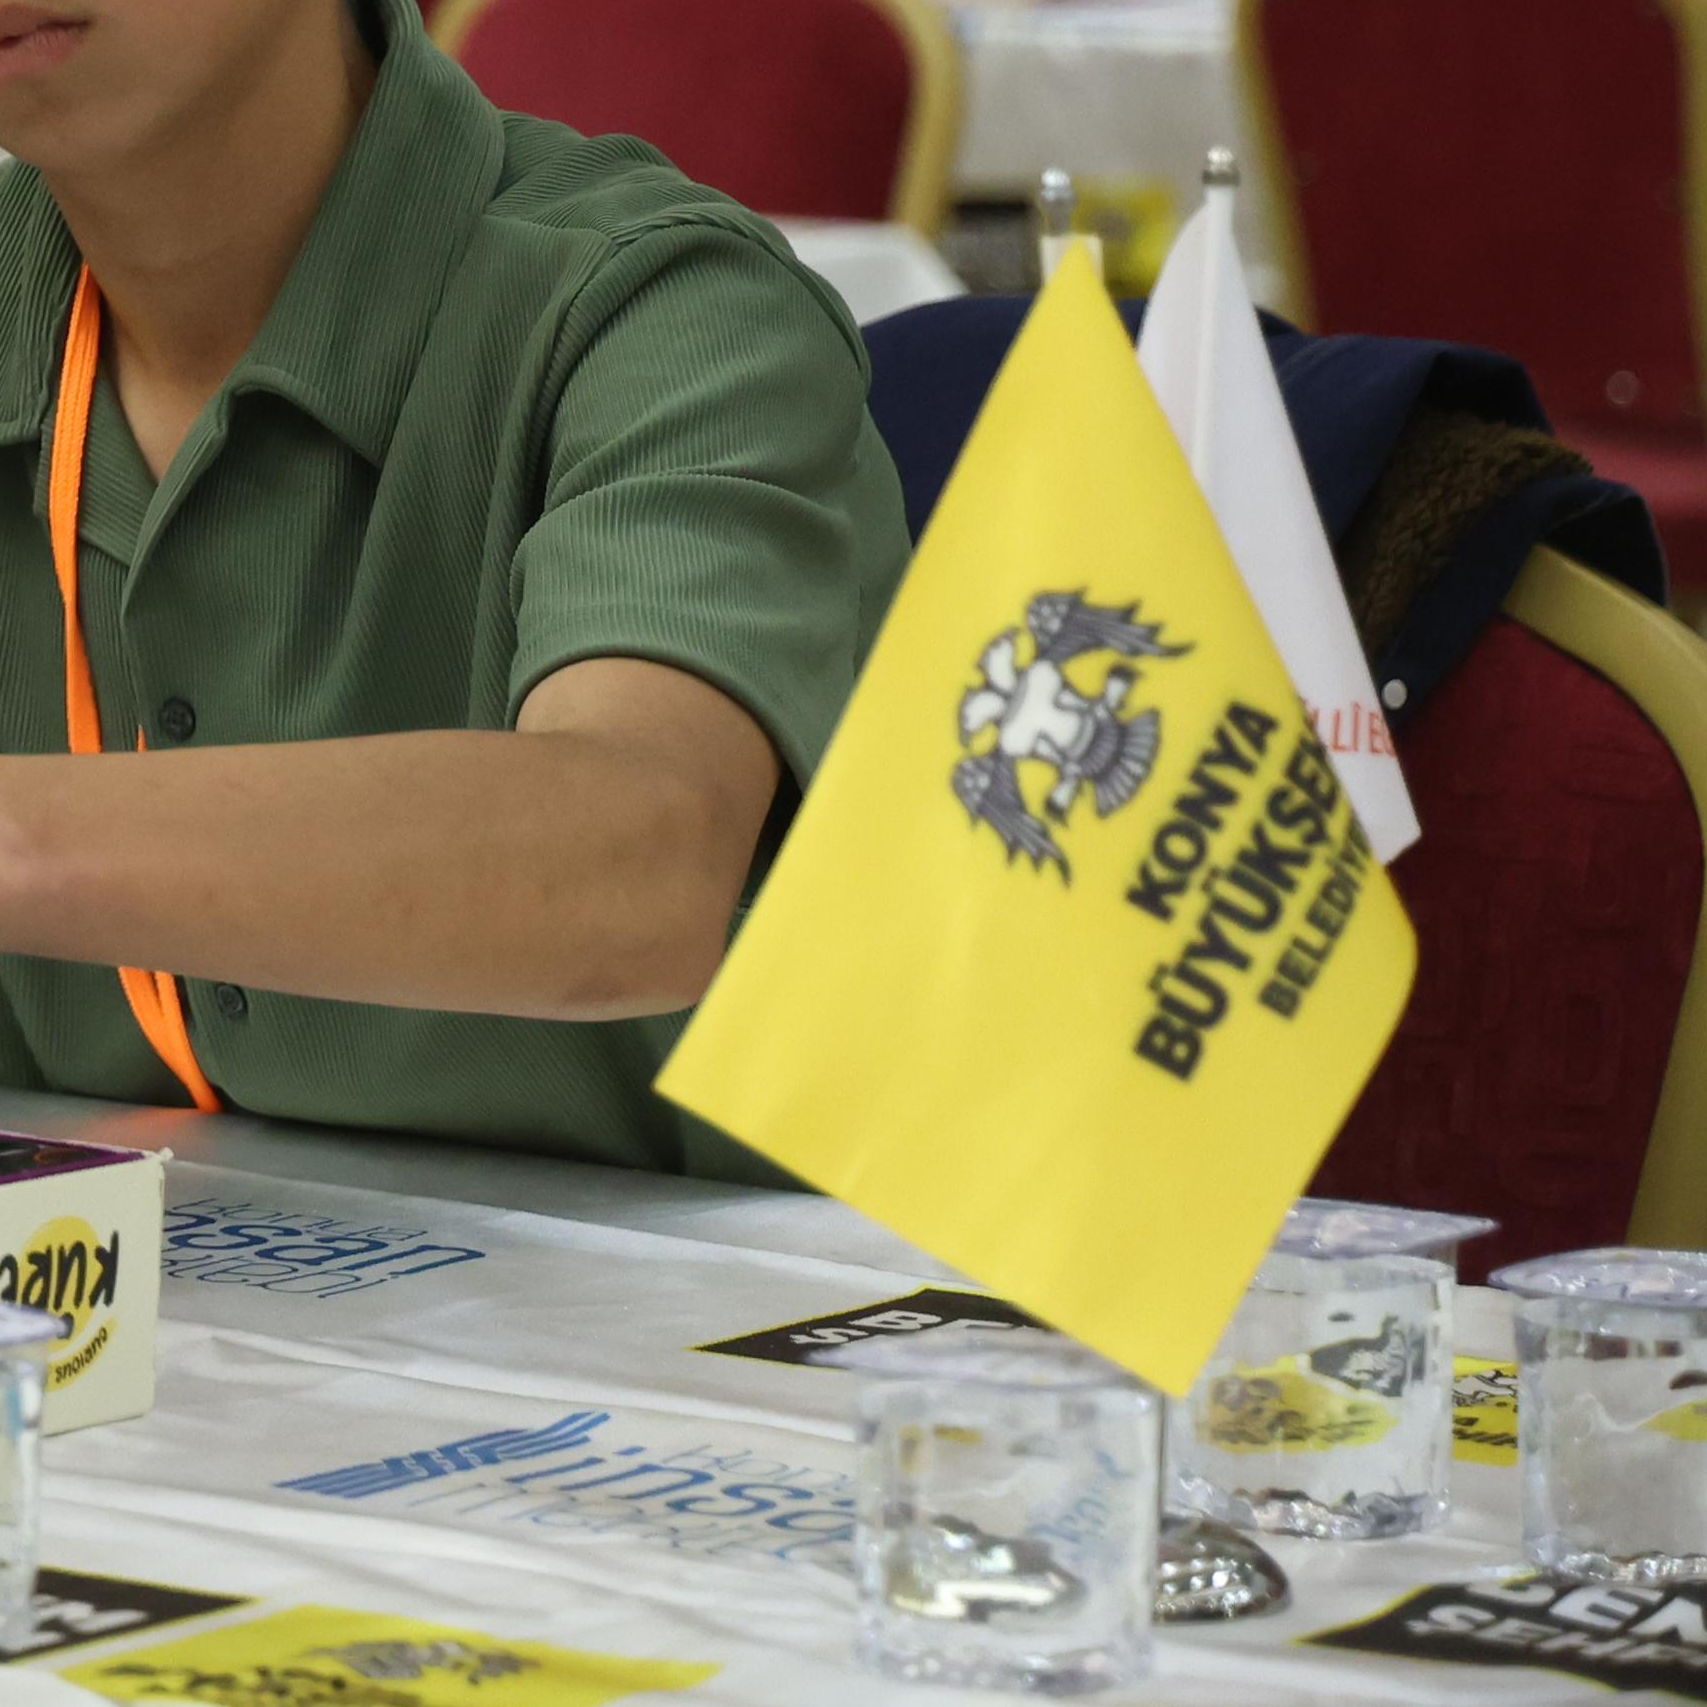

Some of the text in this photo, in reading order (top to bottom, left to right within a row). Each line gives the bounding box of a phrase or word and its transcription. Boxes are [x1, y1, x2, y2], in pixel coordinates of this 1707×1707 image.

[1126, 700, 1279, 924] KONYA
[1134, 736, 1341, 1083] BÜYÜKŞE
[54, 1327, 109, 1384] CURIOUS
[507, 1445, 855, 1542] insa
